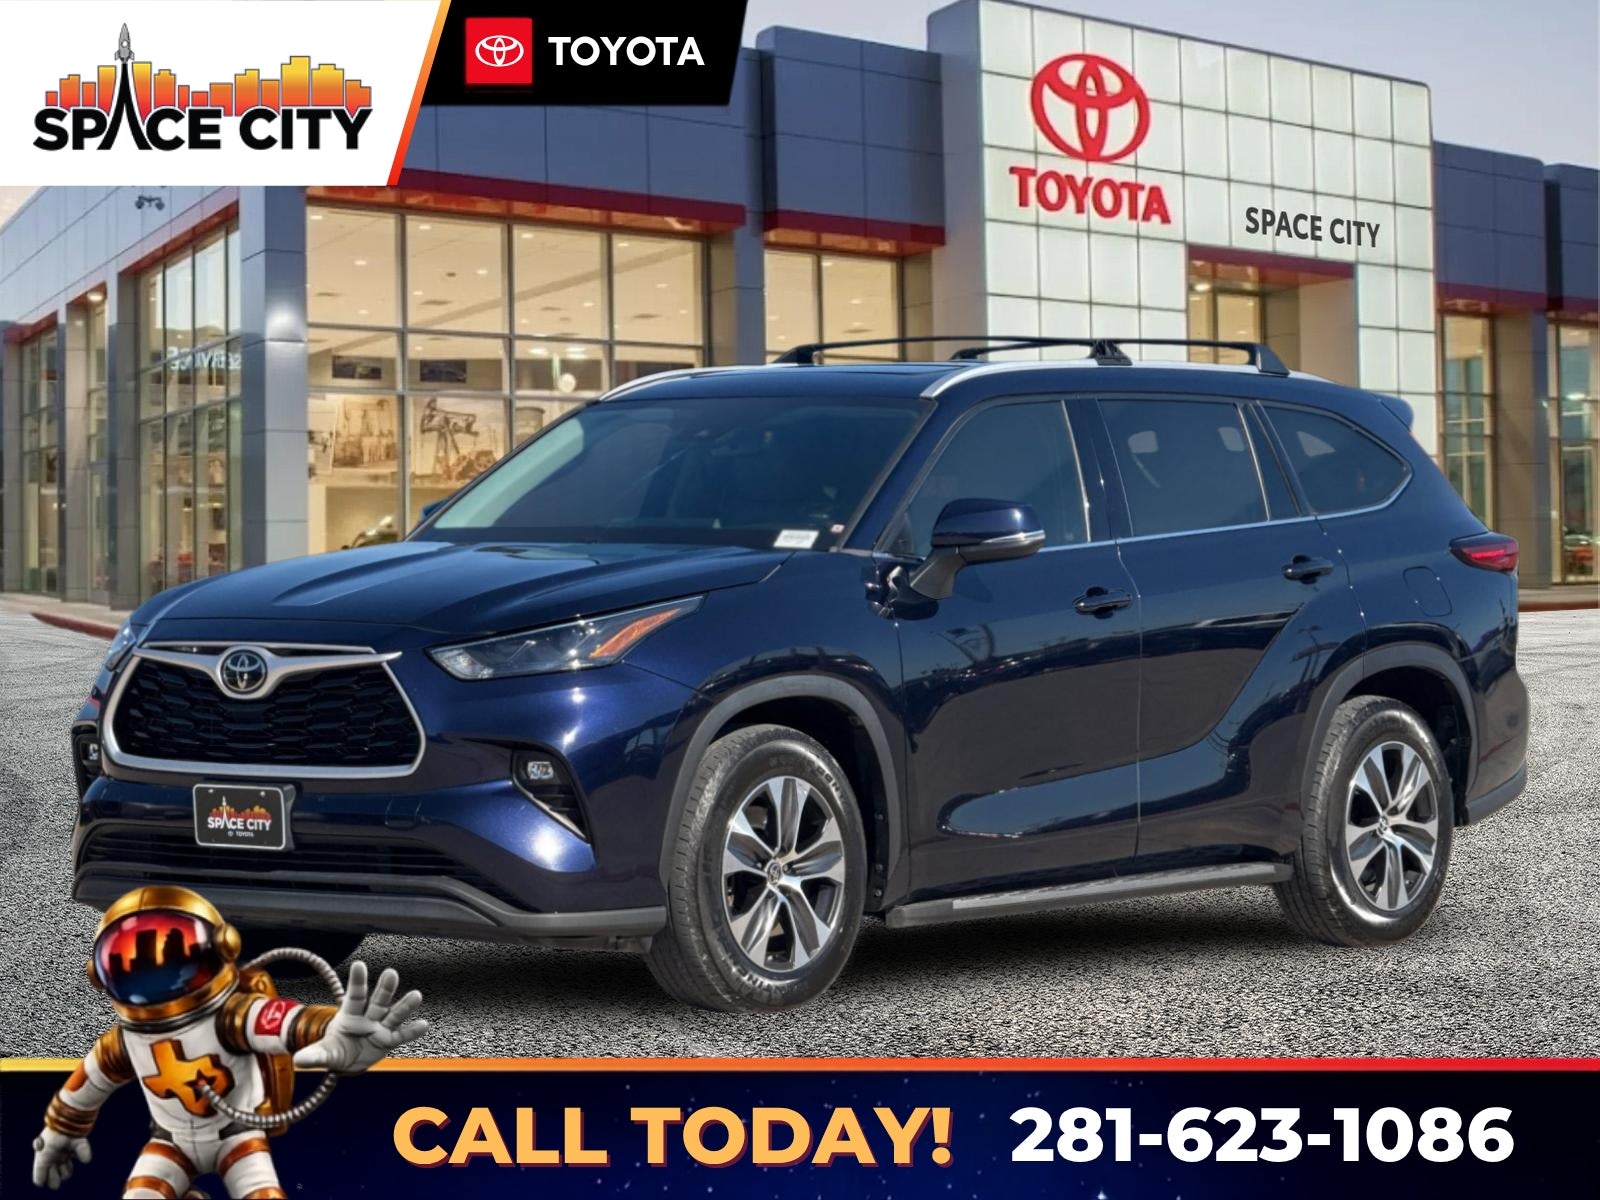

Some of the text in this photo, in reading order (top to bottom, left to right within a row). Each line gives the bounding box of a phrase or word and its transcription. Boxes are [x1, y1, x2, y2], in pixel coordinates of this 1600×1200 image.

[1009, 166, 1171, 224] TOYOTA
[1245, 206, 1381, 248] SPACE CITY
[208, 817, 272, 831] SPACE CITY
